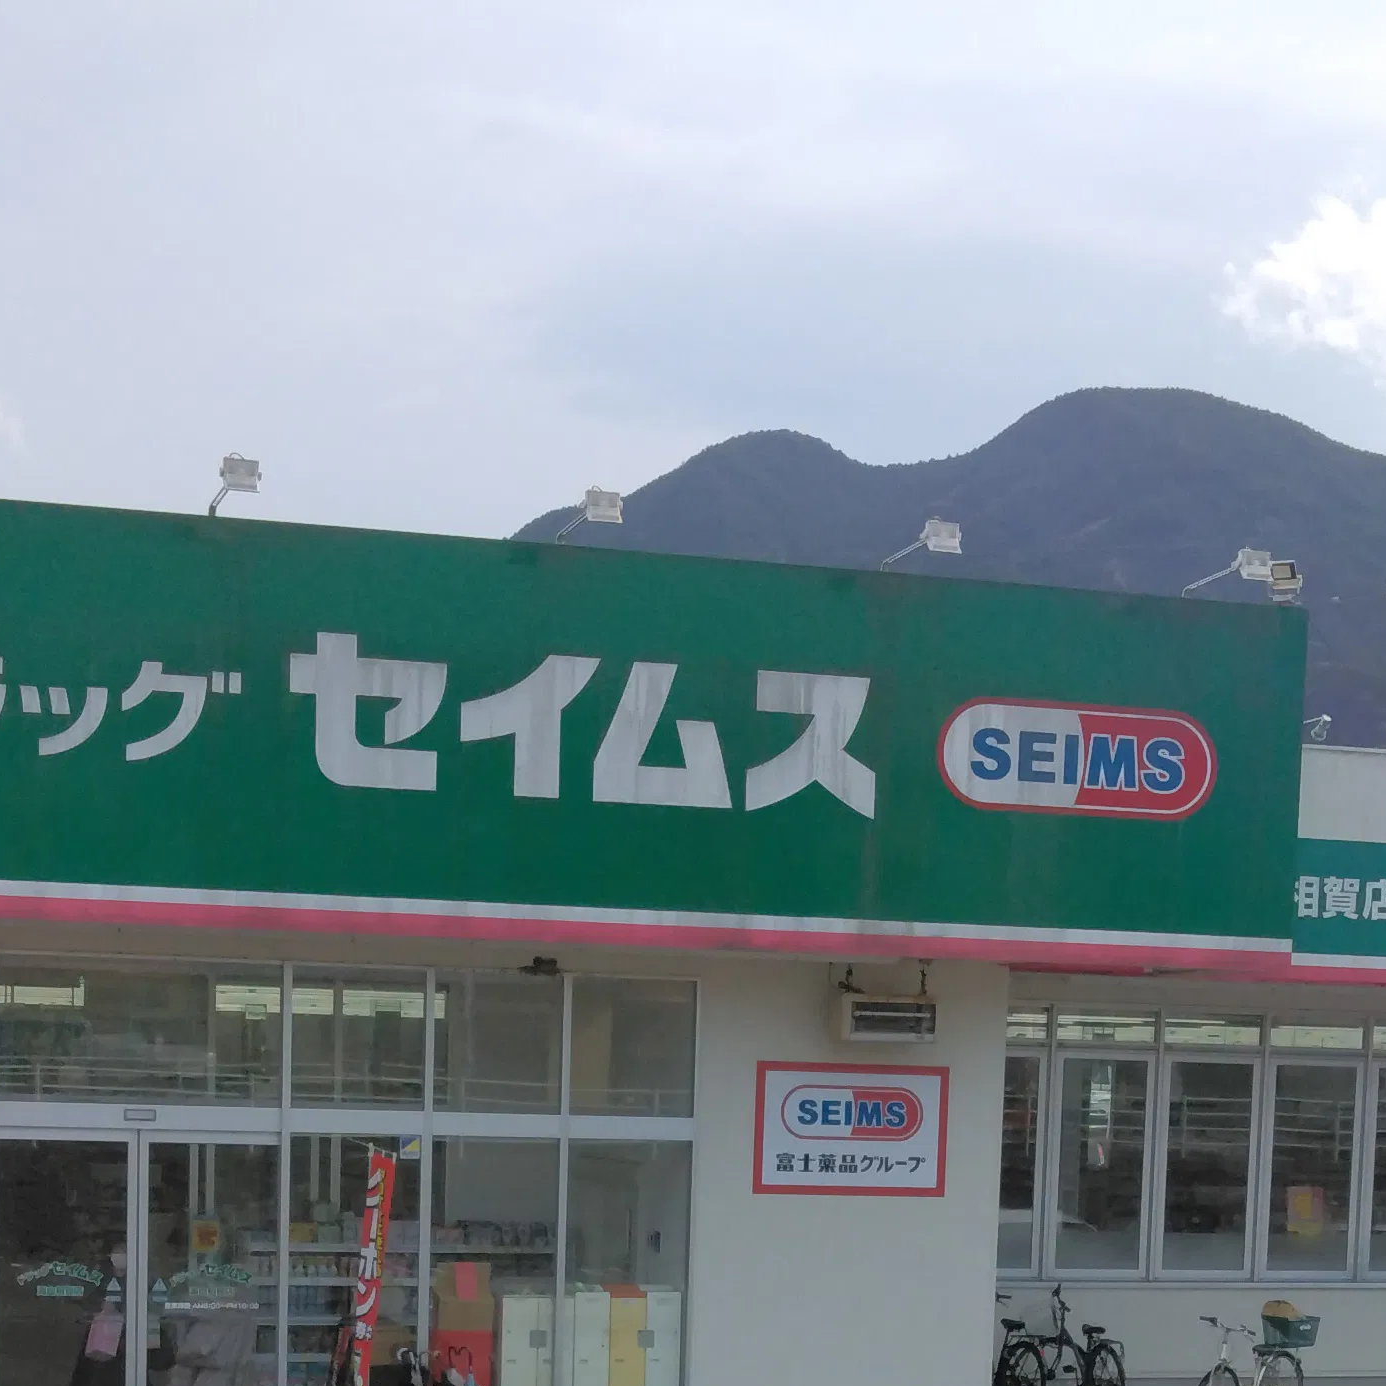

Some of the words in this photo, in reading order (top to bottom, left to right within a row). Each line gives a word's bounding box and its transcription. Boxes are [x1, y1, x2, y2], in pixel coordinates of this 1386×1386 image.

[289, 631, 876, 819] セイムス
[969, 726, 1186, 795] SEIMS
[797, 1098, 907, 1129] SEIMS
[775, 1152, 926, 1174] 富士薬品グループ
